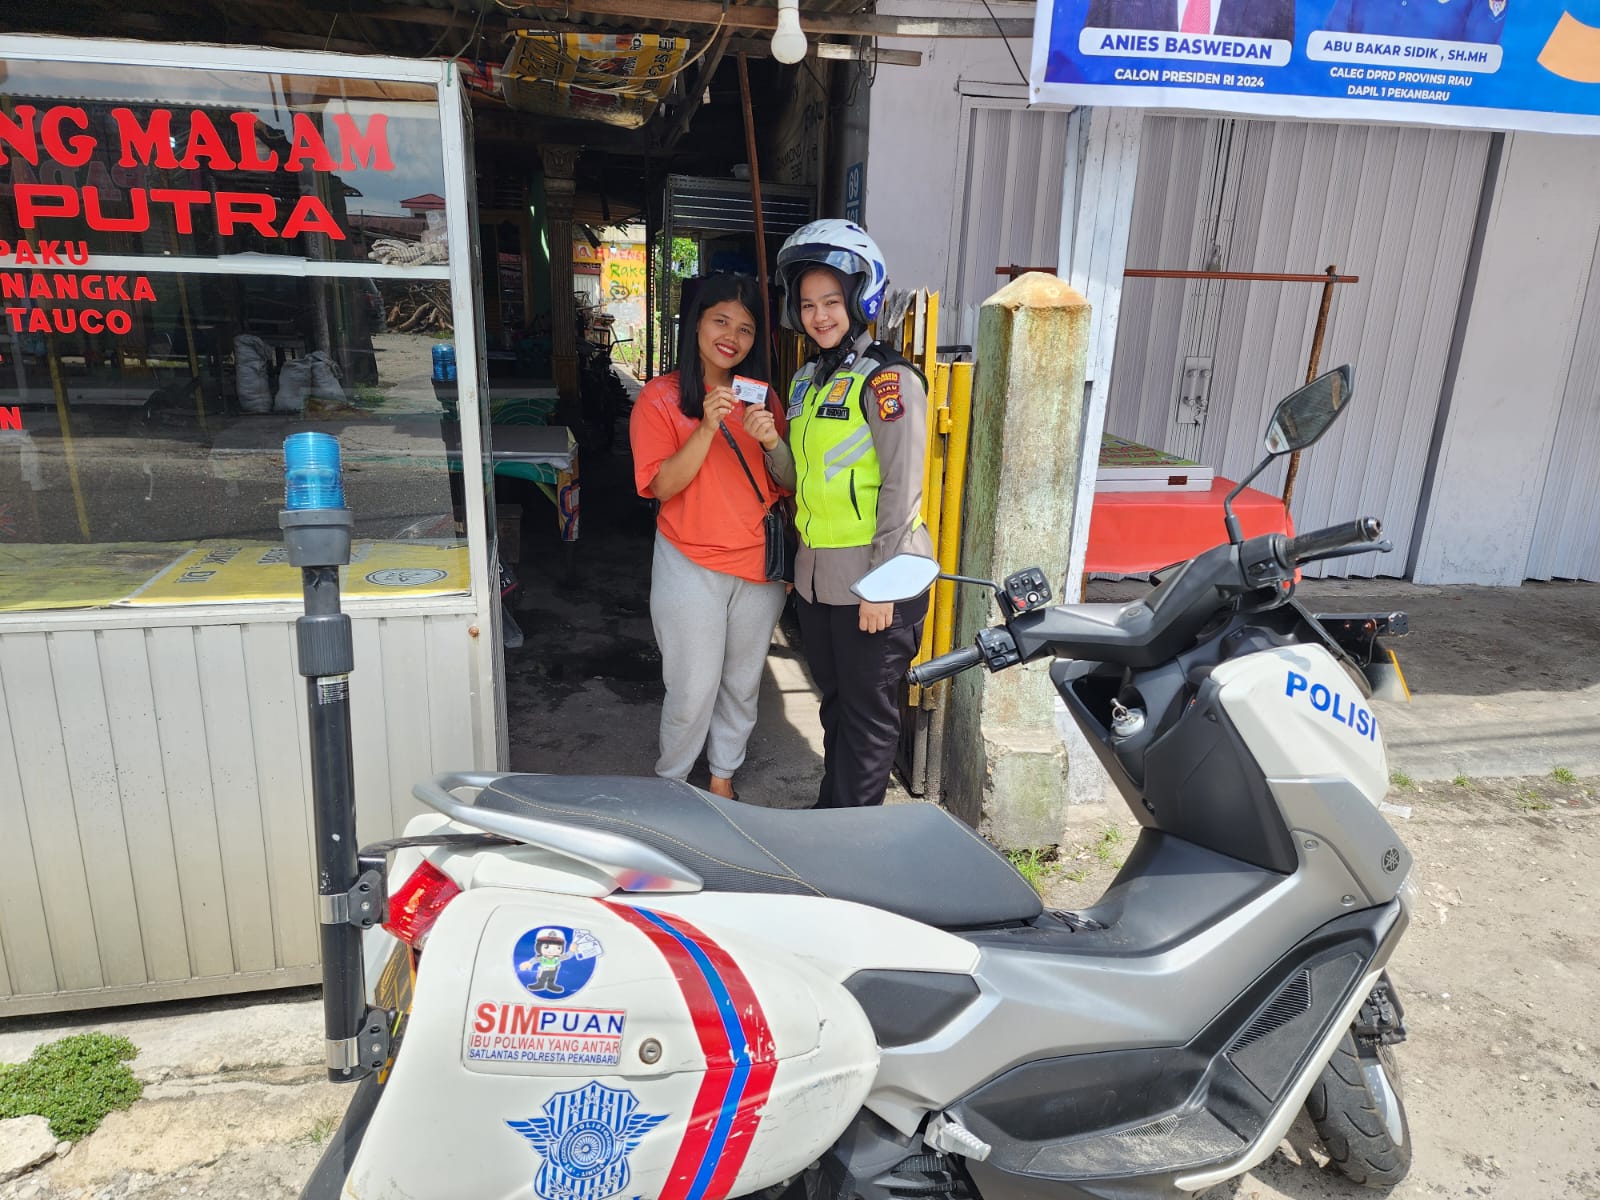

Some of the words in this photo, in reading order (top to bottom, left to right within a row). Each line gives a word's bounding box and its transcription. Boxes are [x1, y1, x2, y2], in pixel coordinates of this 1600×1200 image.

[1100, 34, 1160, 51] ANIES
[1165, 37, 1273, 60] BASWEDAN
[1324, 40, 1353, 51] ABU
[1355, 42, 1401, 57] BAKAR
[1404, 46, 1438, 59] SIDIK
[1447, 49, 1488, 63] SH.MH
[1114, 68, 1160, 82] CALON
[1162, 71, 1221, 85] PRESIDEN
[1223, 75, 1235, 86] RI
[1236, 75, 1265, 88] 2024
[1329, 66, 1364, 79] CALEG
[1366, 69, 1396, 82] DPRD
[1398, 71, 1446, 85] PROVINSI
[1447, 76, 1473, 87] RIAU
[1347, 85, 1380, 97] DAPIL
[1381, 87, 1386, 97] 1
[1387, 88, 1451, 102] PEKANBARU
[111, 106, 396, 174] MALAM
[848, 167, 860, 200] 69
[14, 183, 346, 241] PUTRA
[0, 272, 158, 302] NANGKA
[5, 307, 132, 335] TAUCO
[877, 385, 898, 395] RIAU
[1285, 670, 1377, 743] POLISI
[474, 1002, 624, 1035] SIMPUAN
[470, 1034, 491, 1048] IBU
[494, 1036, 544, 1050] POLWAN
[548, 1038, 579, 1052] YANG
[582, 1040, 621, 1054] ANTAR
[469, 1049, 519, 1060] SATLANTAS
[521, 1051, 566, 1062] POLRESTA
[567, 1053, 619, 1065] PEKANBARU
[572, 1122, 606, 1134] POLISI
